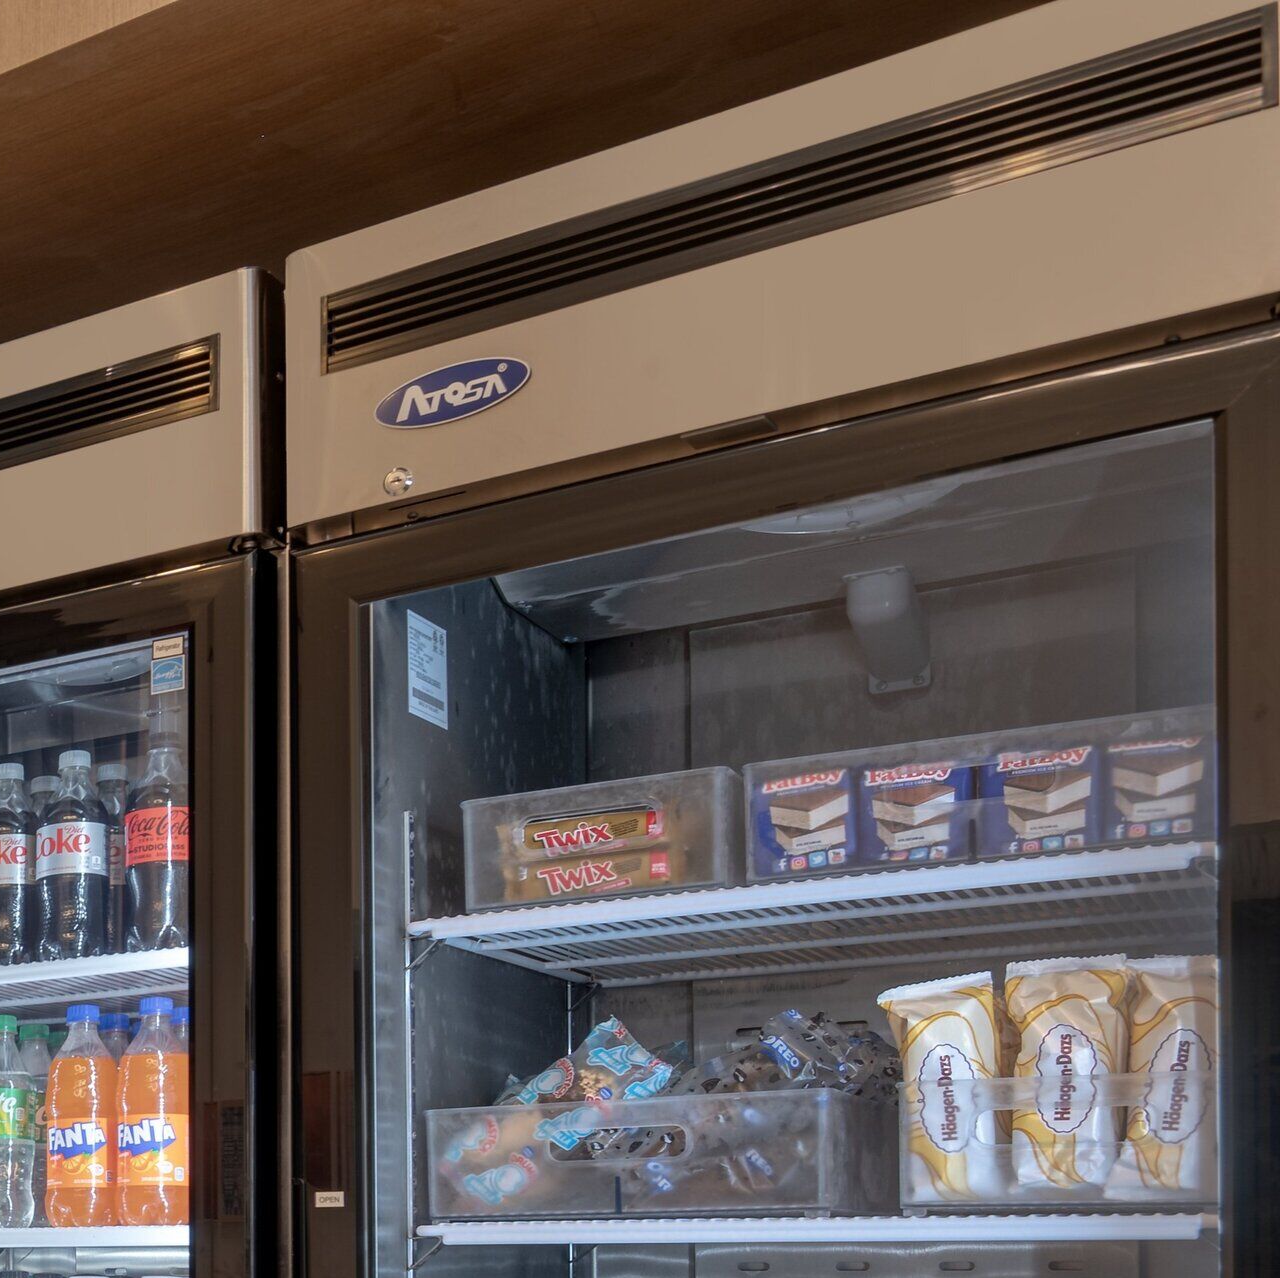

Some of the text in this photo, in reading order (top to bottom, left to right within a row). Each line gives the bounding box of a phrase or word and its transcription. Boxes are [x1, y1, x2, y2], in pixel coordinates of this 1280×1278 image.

[763, 1035, 800, 1068] OREO
[49, 1121, 106, 1151] FANTA
[118, 1116, 176, 1150] FANTA
